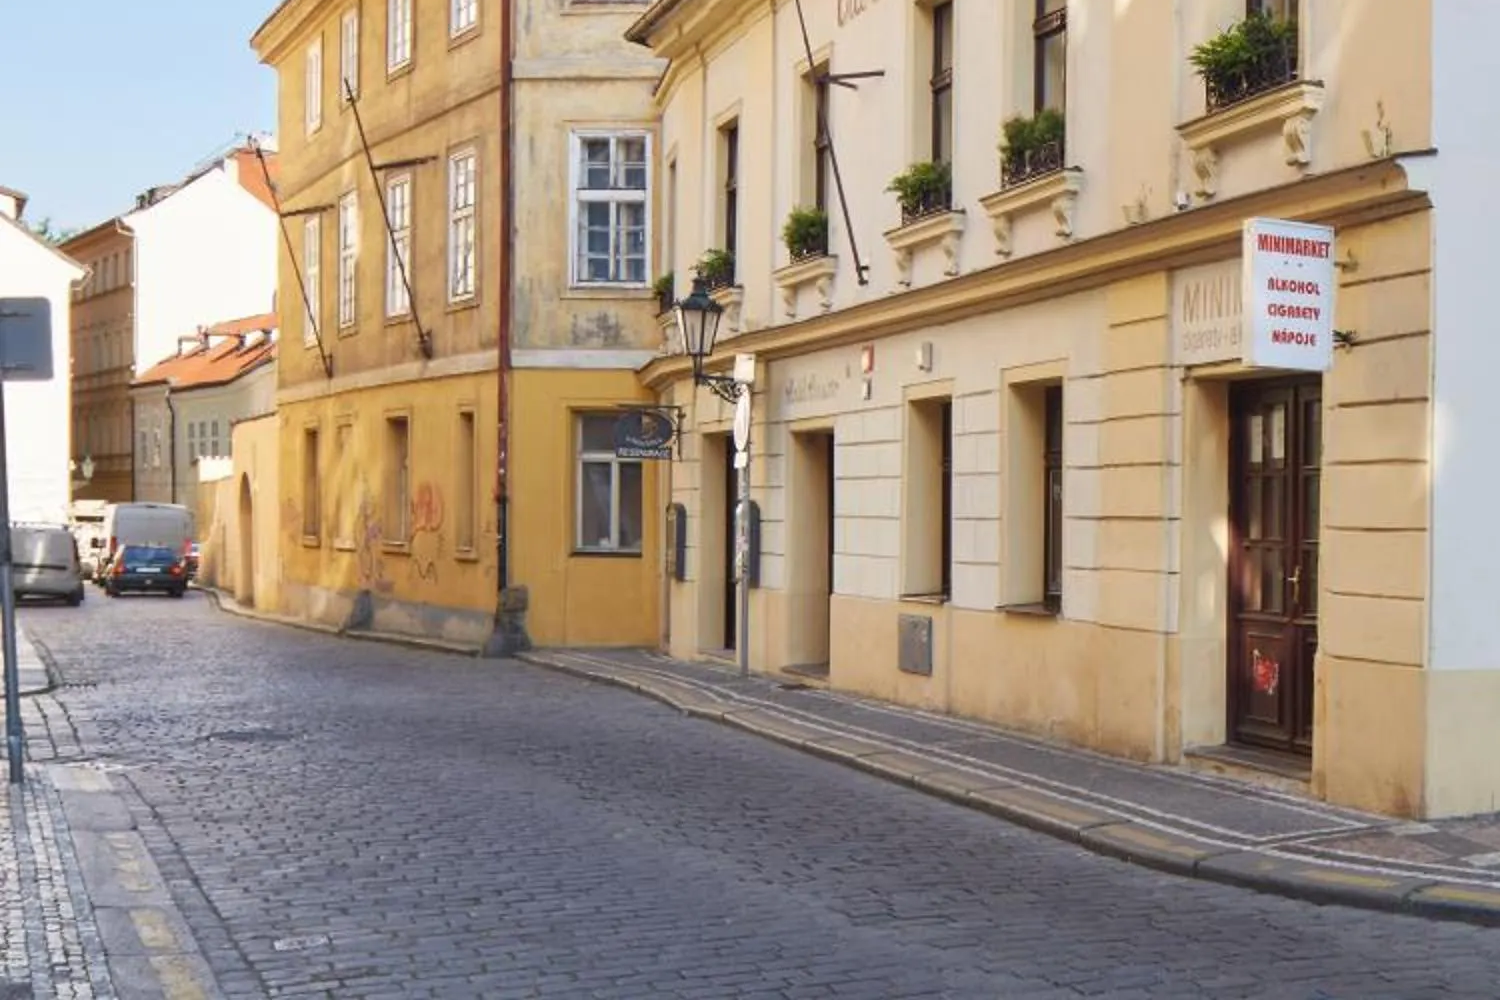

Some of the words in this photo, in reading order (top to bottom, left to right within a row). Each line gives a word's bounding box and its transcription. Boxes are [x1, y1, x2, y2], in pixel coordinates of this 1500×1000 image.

[1257, 234, 1330, 258] MINIMARKET
[1267, 276, 1321, 296] ALKOHOL
[1267, 303, 1321, 322] CIGARETY
[1271, 327, 1317, 347] NÁPOJE
